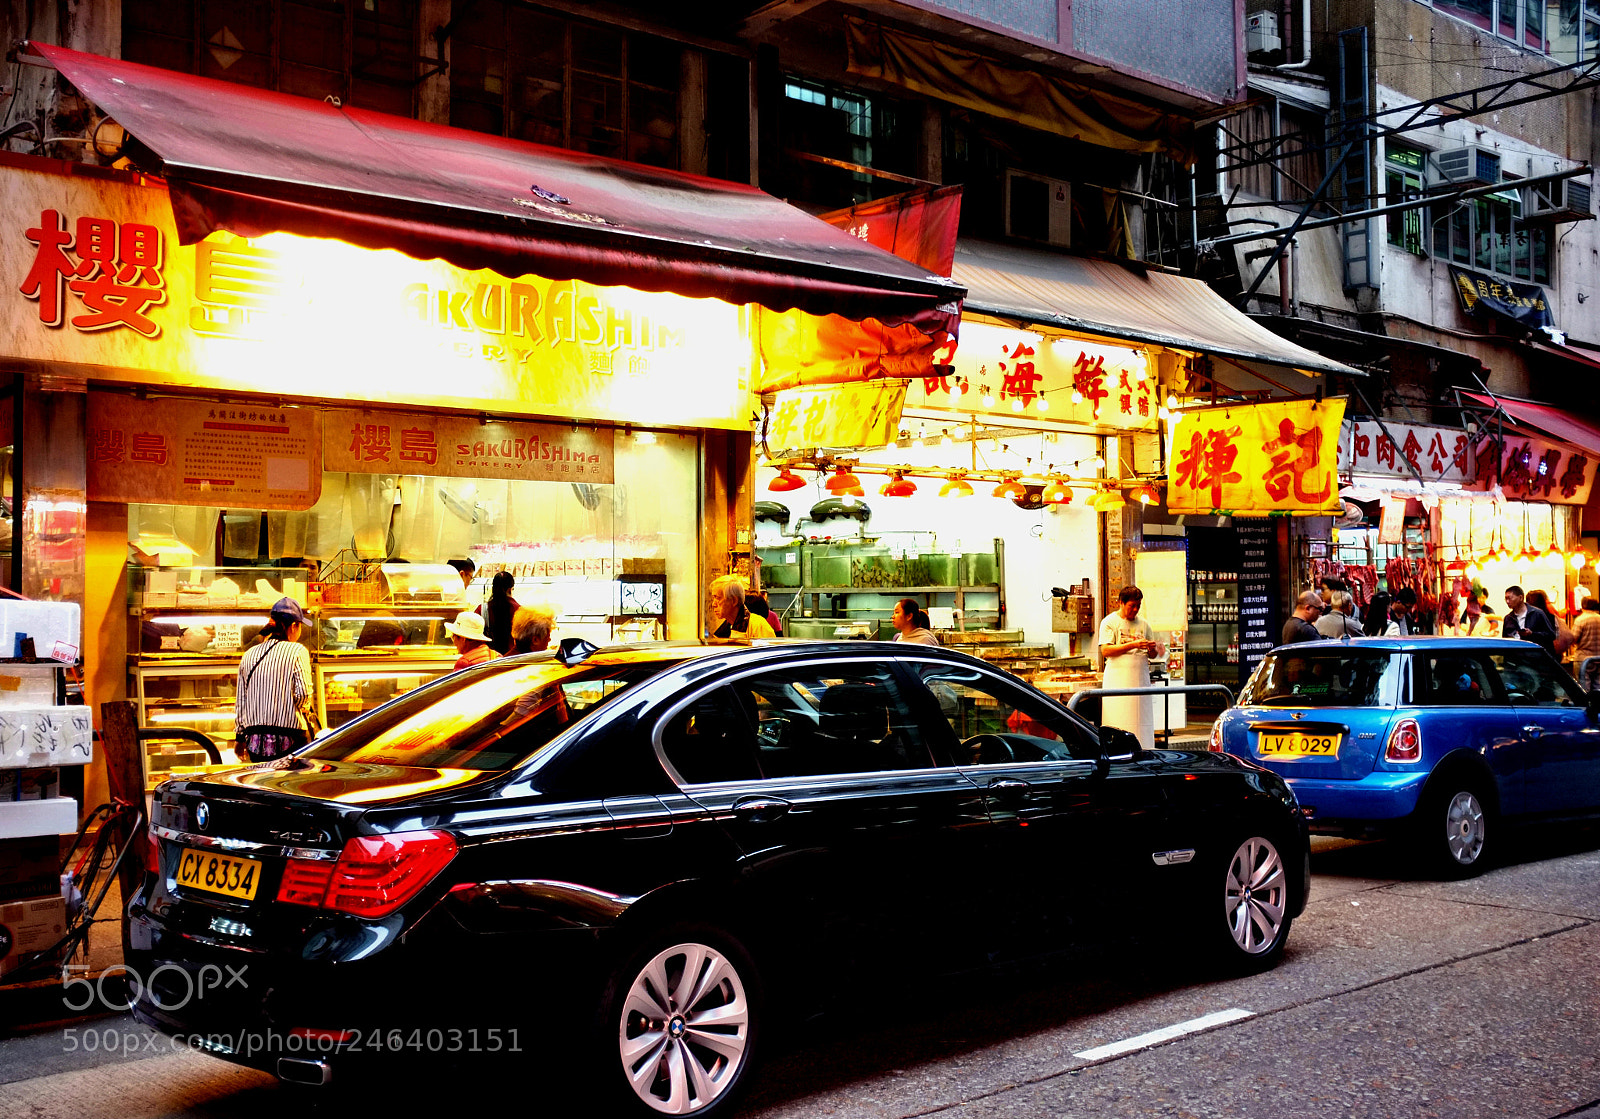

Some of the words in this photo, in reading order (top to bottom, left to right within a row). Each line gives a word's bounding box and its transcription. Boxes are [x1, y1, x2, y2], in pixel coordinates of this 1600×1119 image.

[350, 422, 437, 466] 櫻島
[456, 434, 600, 464] SAKURASHIMA
[456, 459, 523, 469] BAKERY
[1175, 417, 1332, 510] 輝記
[1337, 422, 1470, 477] 和肉食公司
[1263, 737, 1284, 752] LV
[1288, 738, 1332, 753] 8029
[182, 853, 205, 884] CX
[205, 857, 256, 895] 8334
